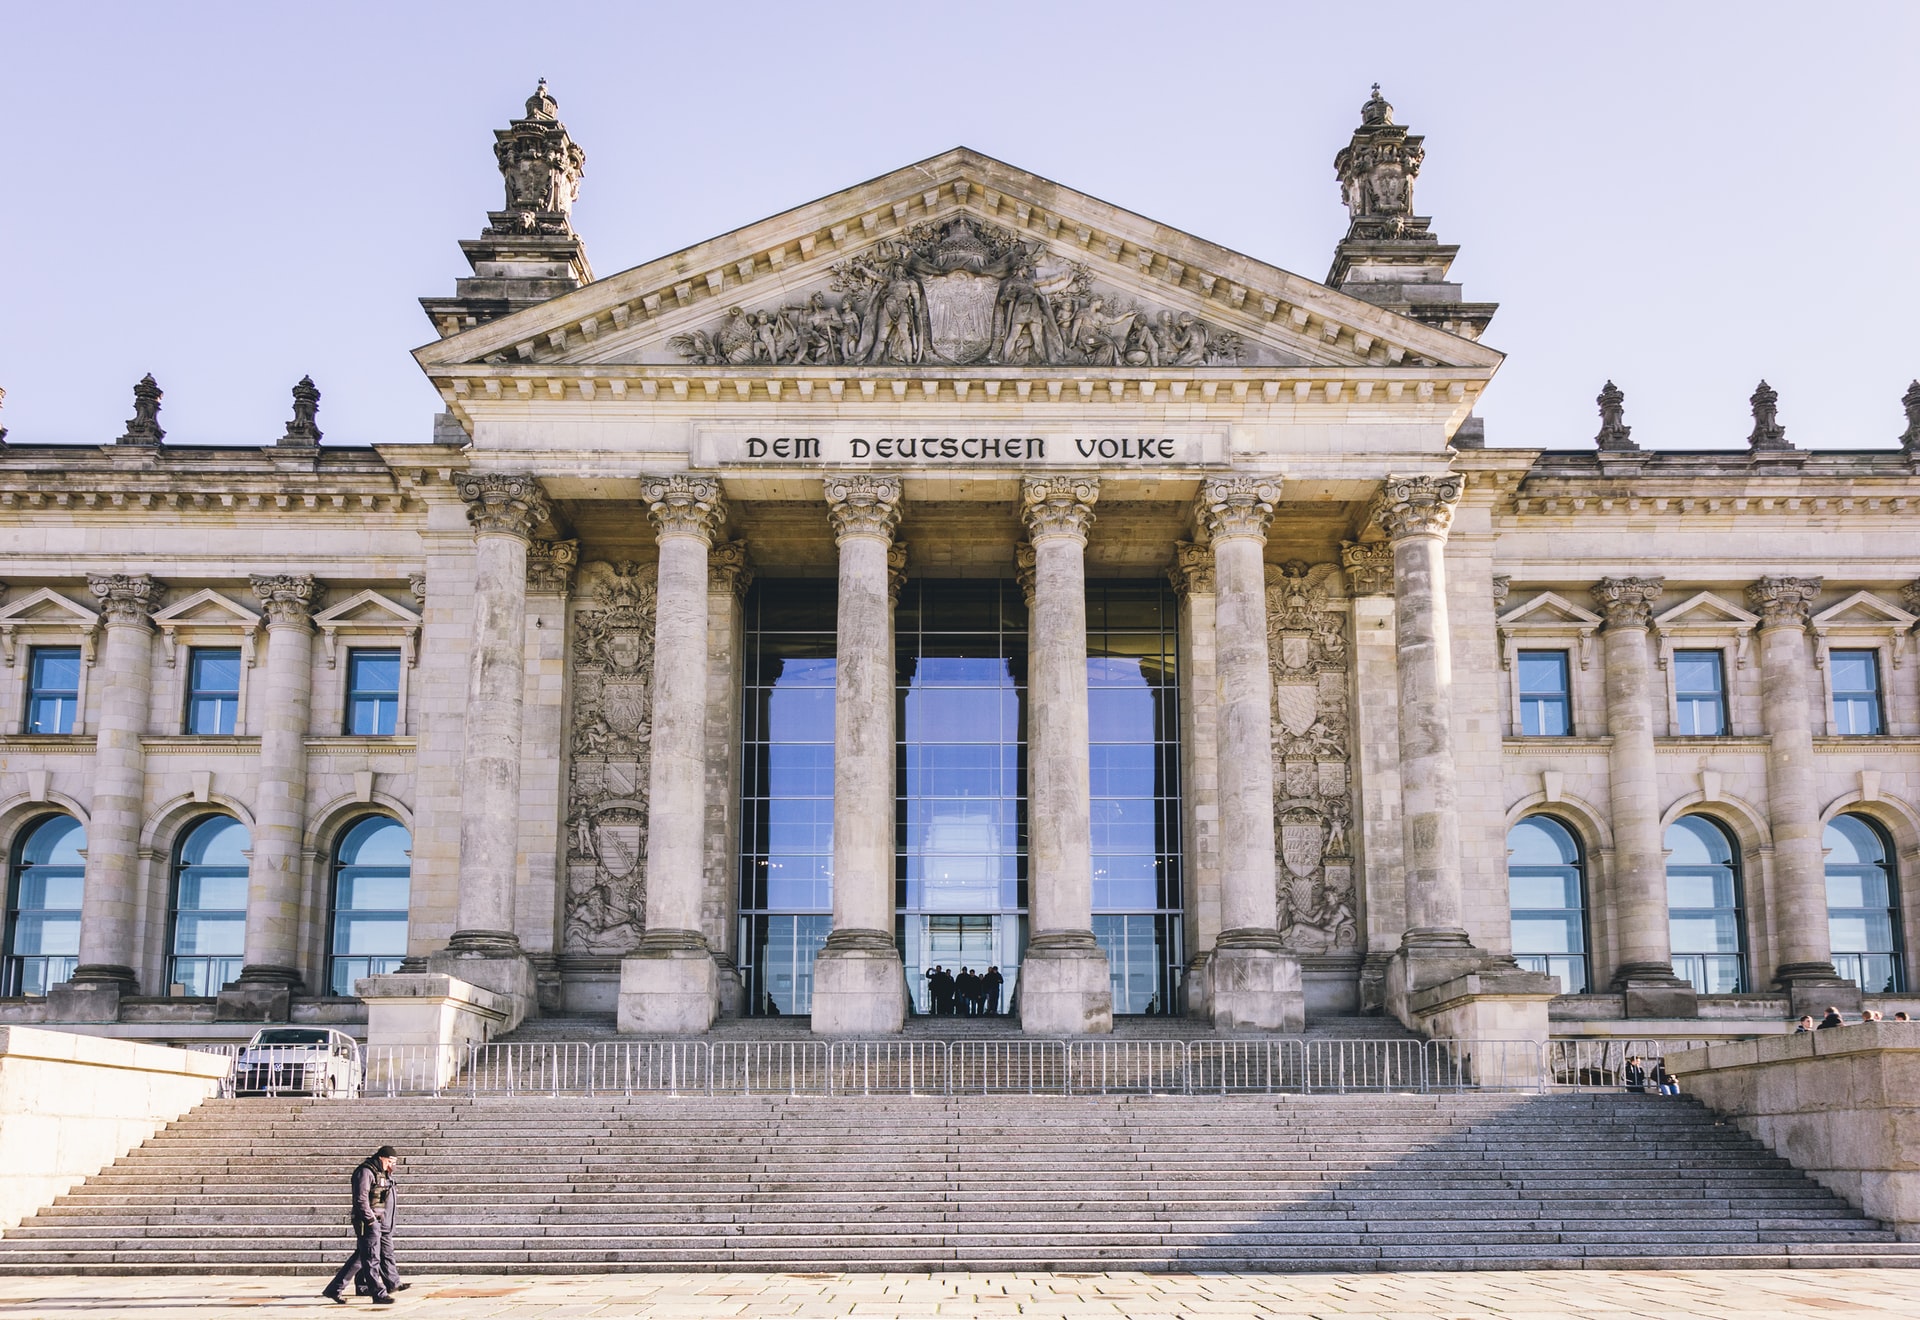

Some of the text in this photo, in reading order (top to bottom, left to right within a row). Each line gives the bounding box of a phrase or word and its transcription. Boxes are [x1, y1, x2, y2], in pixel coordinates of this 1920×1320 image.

[746, 437, 1175, 460] DEM DEUTSCHEN VOLKE
